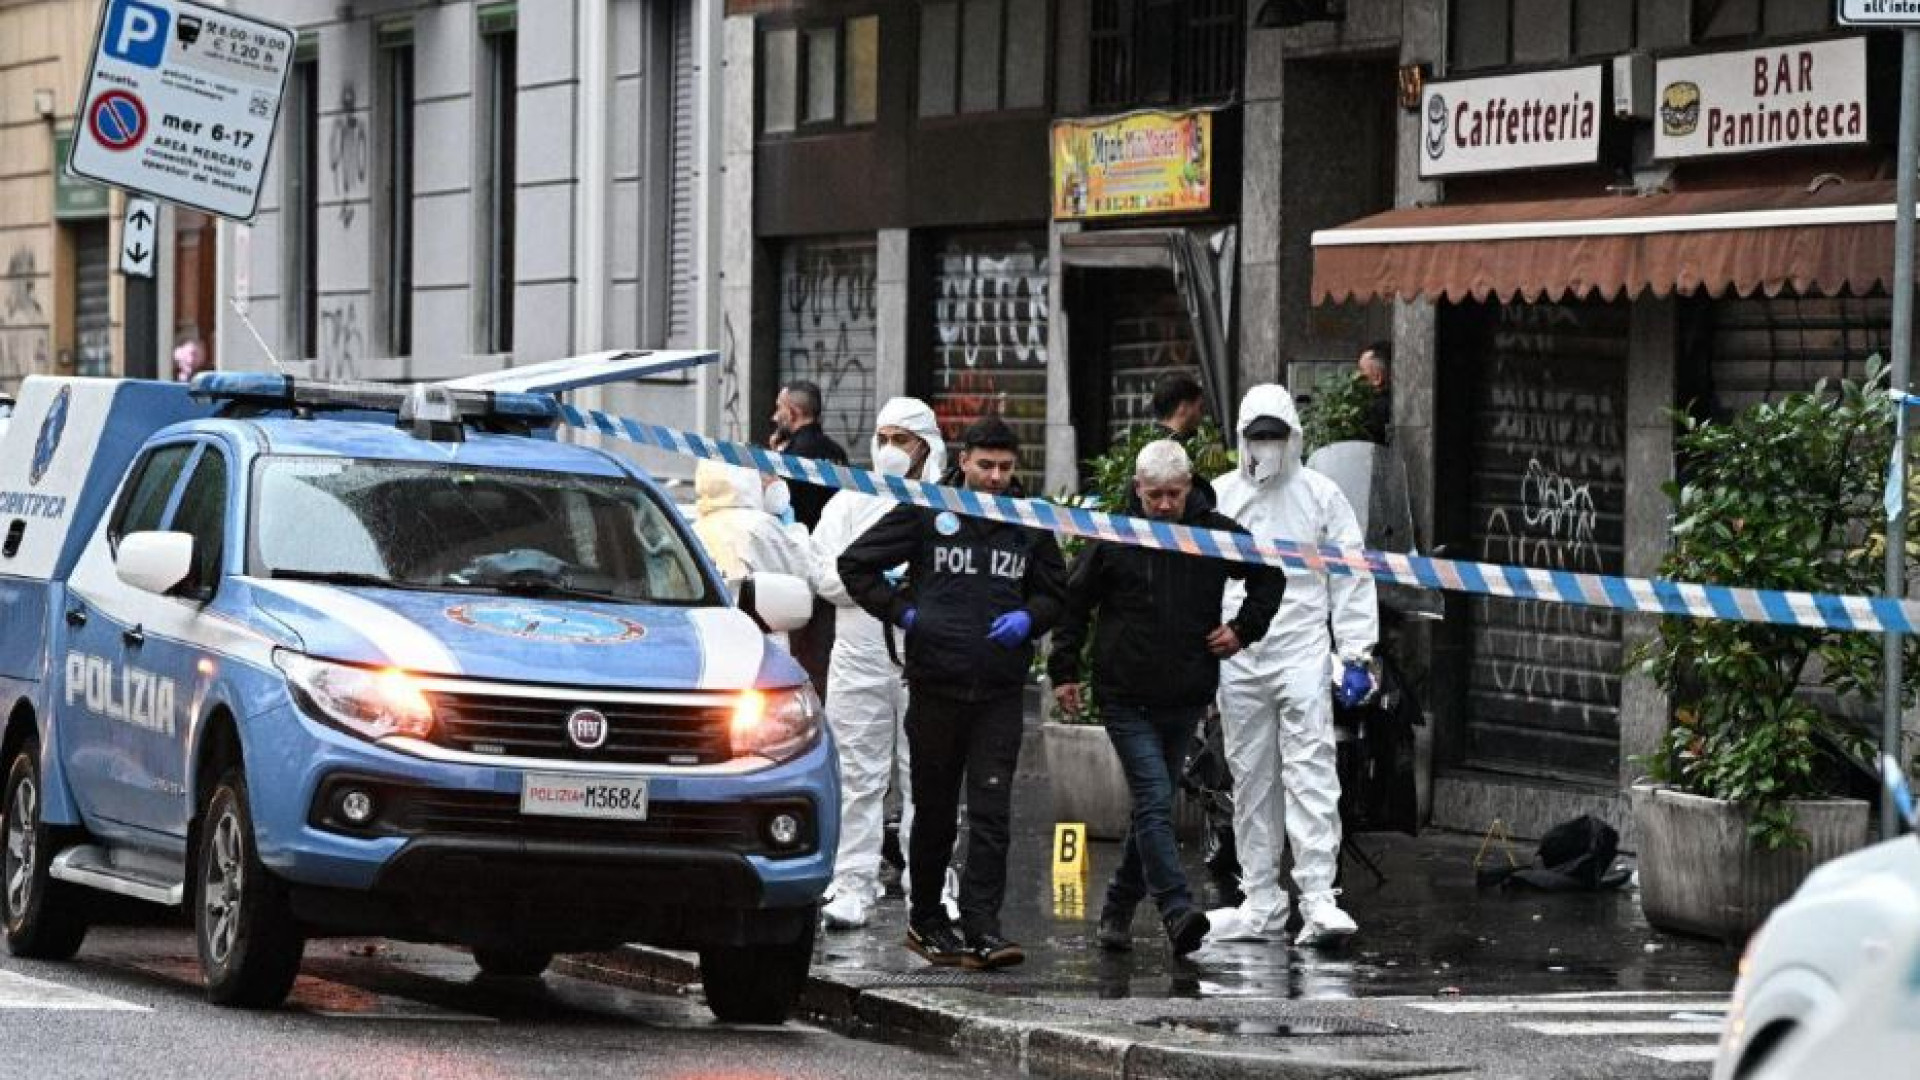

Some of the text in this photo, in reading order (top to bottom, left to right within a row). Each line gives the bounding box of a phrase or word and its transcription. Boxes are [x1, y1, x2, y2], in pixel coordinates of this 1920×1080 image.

[116, 6, 158, 55] P
[1753, 51, 1814, 97] BAR
[162, 113, 254, 149] mer 6-17
[1455, 90, 1594, 148] Caffetteria
[1707, 101, 1862, 148] Paninoteca
[154, 135, 252, 172] AREA MERCATO
[66, 650, 176, 737] POLIZIA
[577, 719, 600, 738] FIAT
[530, 785, 643, 811] POLIZIA M3684
[1060, 829, 1077, 862] B
